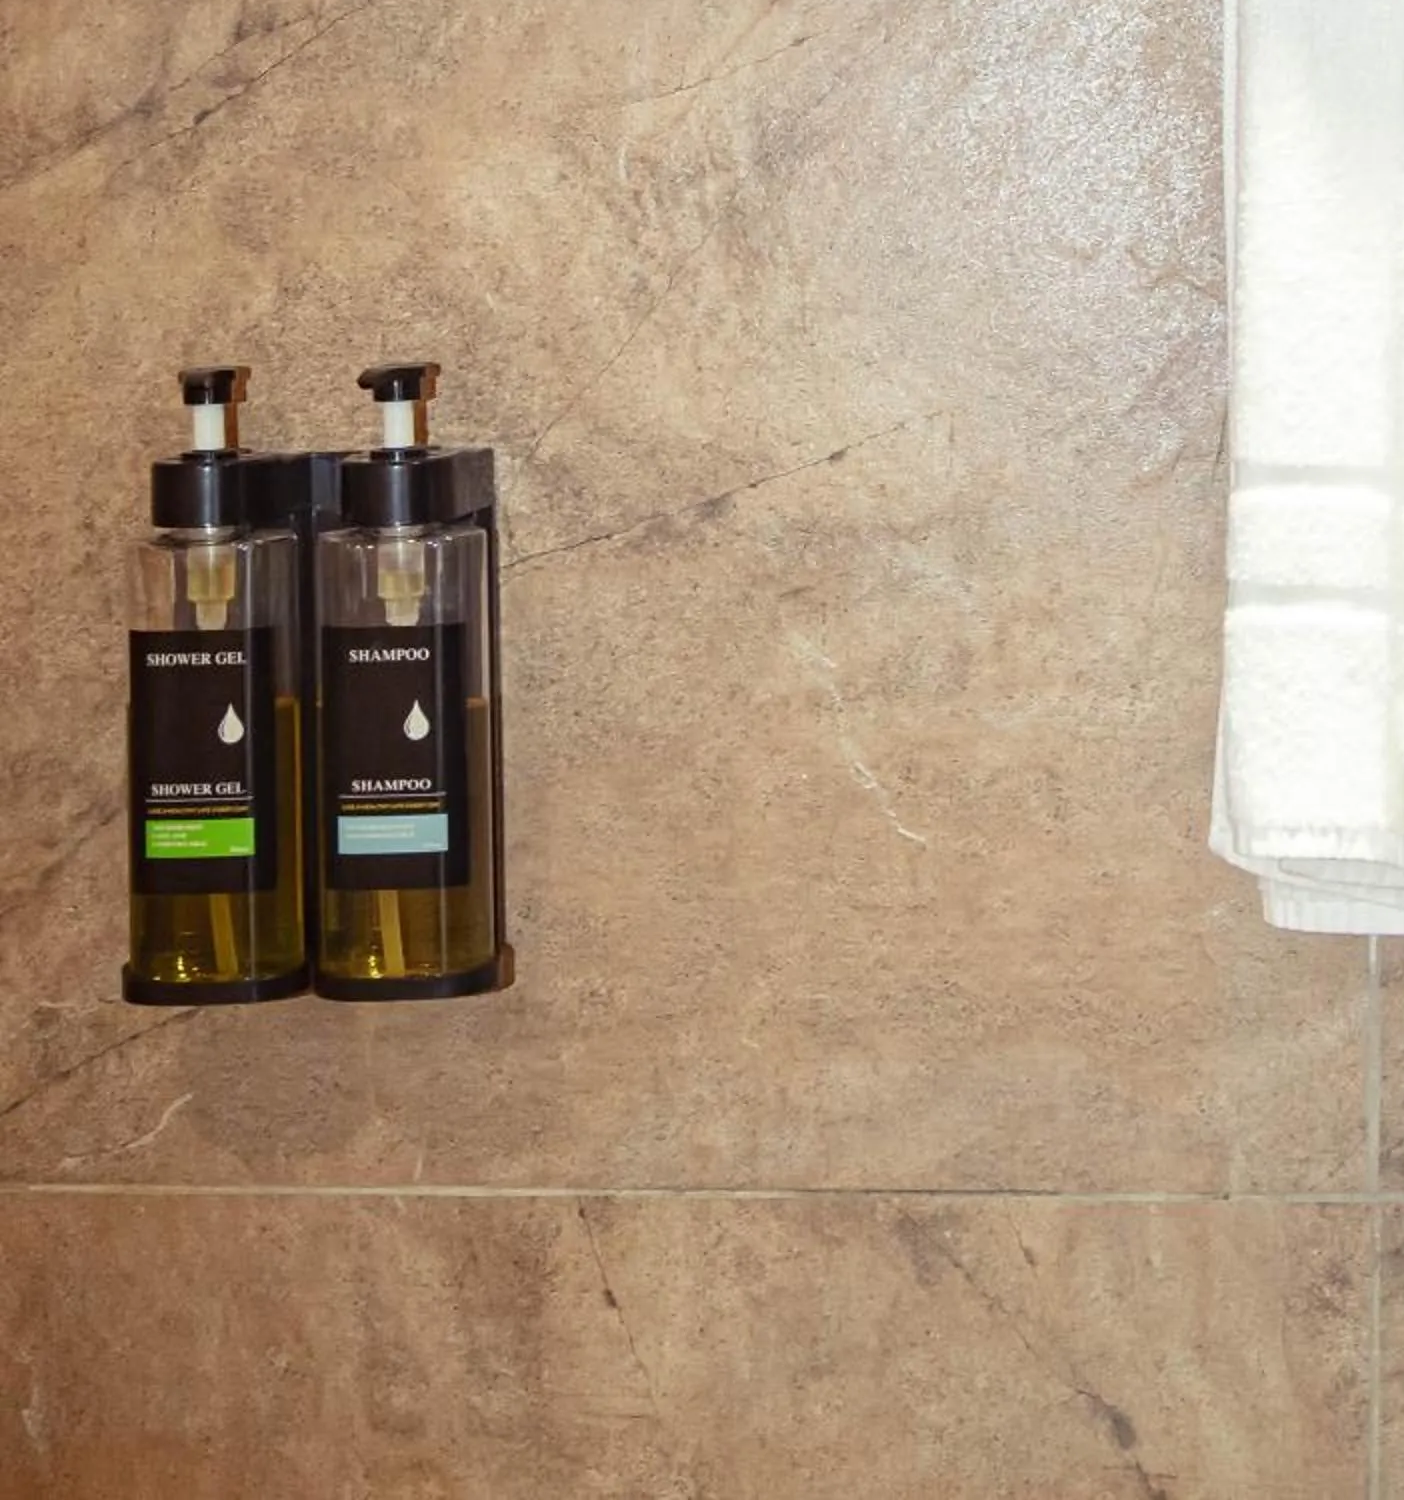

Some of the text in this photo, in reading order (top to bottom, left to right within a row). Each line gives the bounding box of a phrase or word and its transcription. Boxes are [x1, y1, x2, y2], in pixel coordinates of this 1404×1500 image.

[147, 651, 247, 666] SHOWER GEL
[349, 648, 430, 662] SHAMPOO
[151, 781, 246, 796] SHOWER GEL
[351, 778, 432, 792] SHAMPOO
